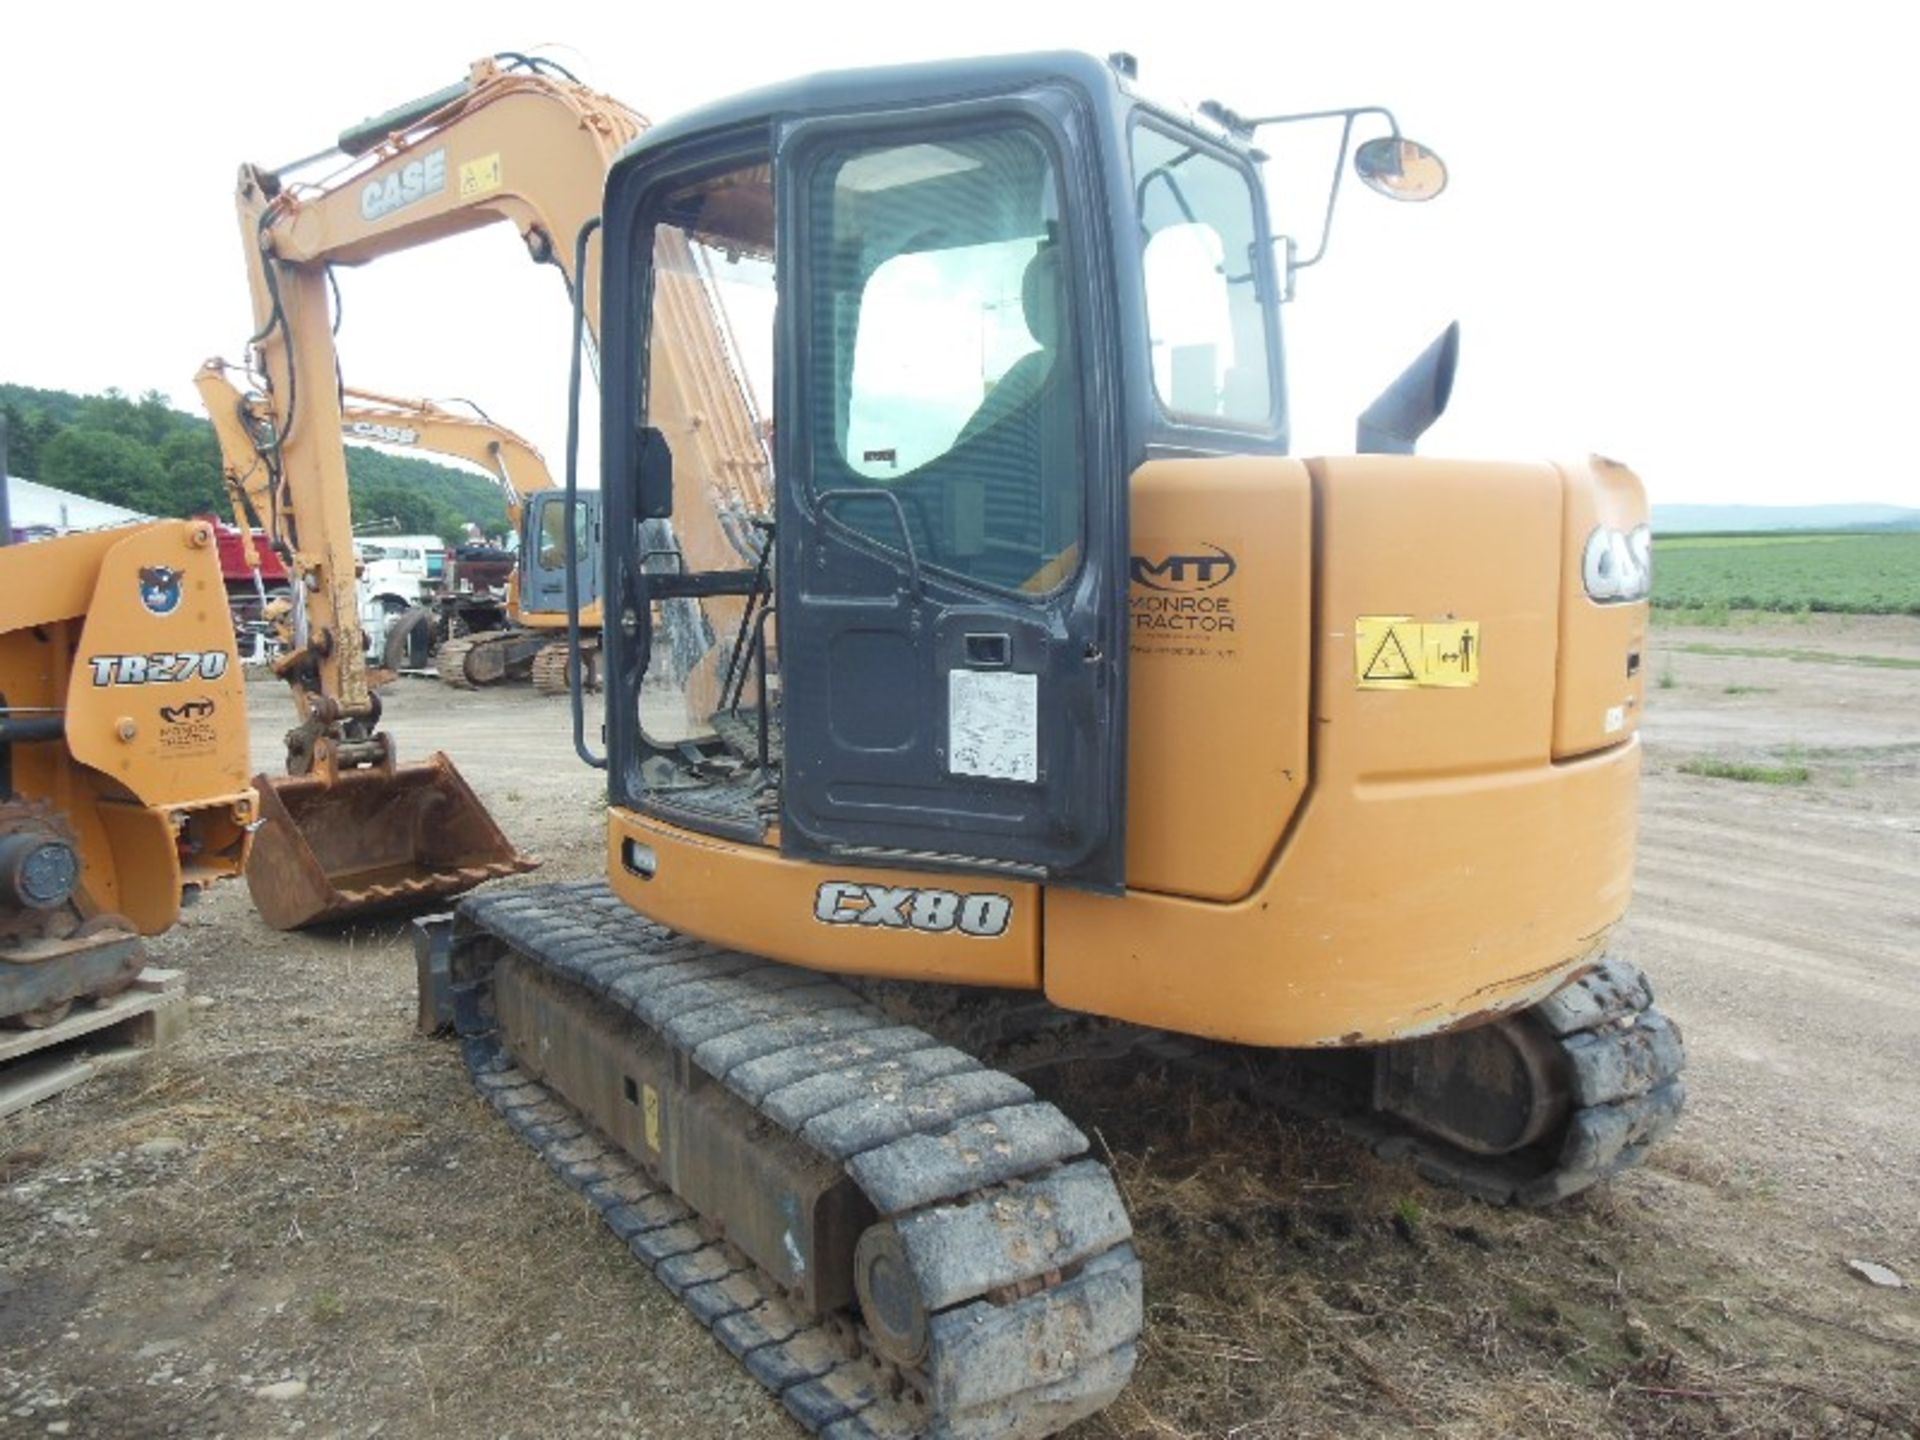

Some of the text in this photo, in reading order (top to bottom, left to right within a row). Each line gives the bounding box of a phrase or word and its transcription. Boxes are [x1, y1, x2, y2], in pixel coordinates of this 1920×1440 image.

[361, 147, 447, 221] CASE
[353, 421, 416, 445] CASE
[89, 650, 228, 687] TR270
[815, 880, 1012, 937] CX80
